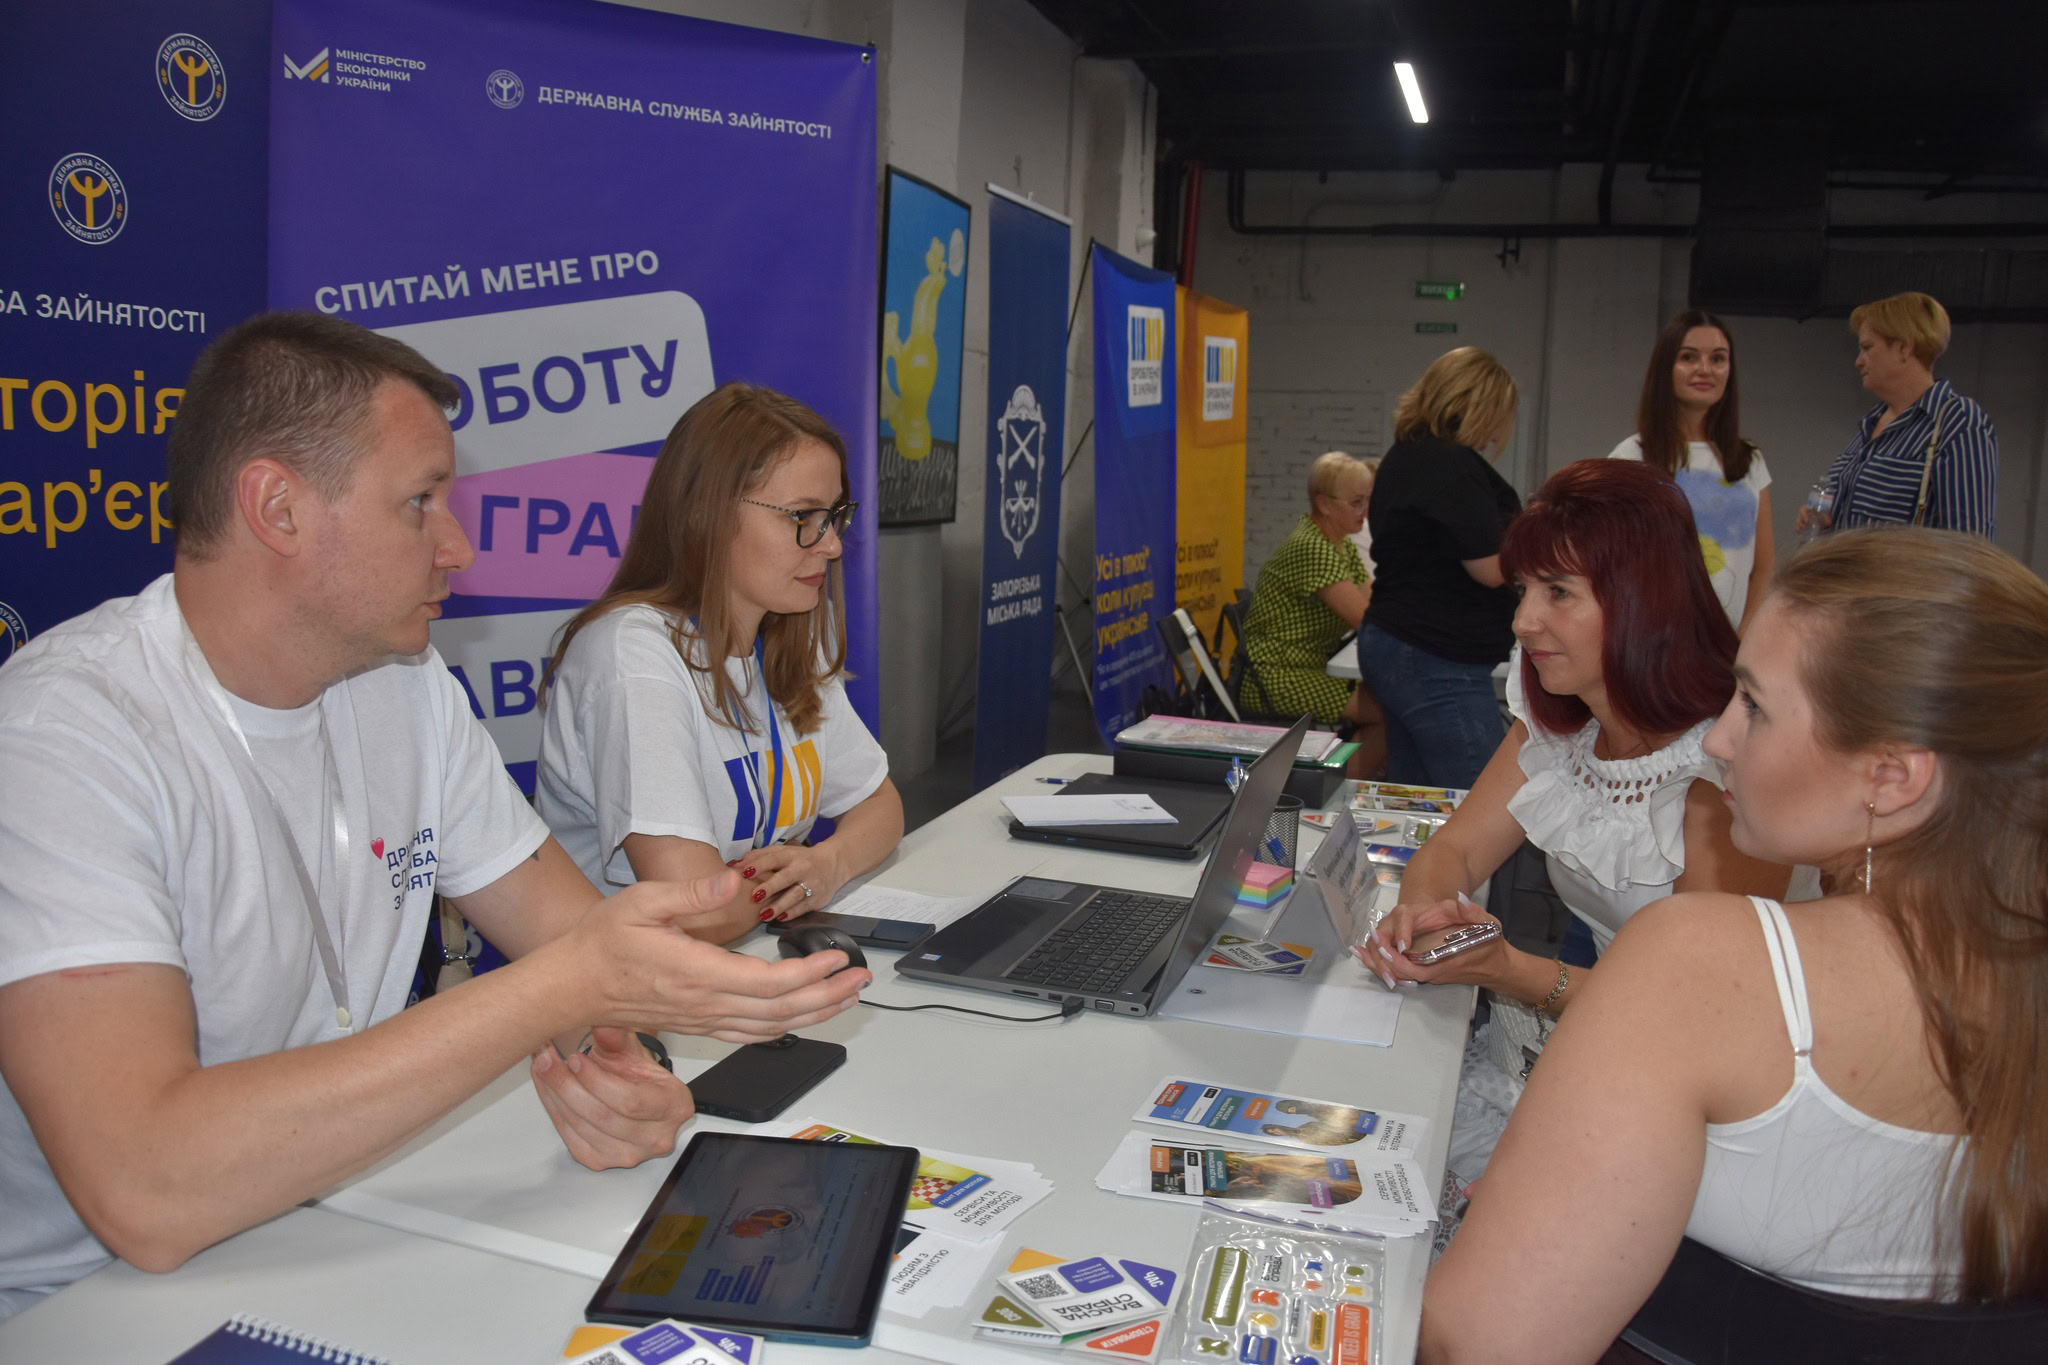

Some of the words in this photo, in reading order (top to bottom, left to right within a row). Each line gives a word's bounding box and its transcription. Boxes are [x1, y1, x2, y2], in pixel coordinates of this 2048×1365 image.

[161, 38, 195, 62] ДЕРЖАВНА
[196, 43, 221, 76] СЛУЖБА
[336, 48, 426, 72] МІНІСТЕРСТВО
[336, 62, 411, 83] ЕКОНОМІКИ
[336, 74, 391, 93] УКРАЇНИ
[170, 95, 214, 117] ЗАЙНЯТОСТІ
[538, 86, 644, 114] ДЕРЖАВНА
[648, 101, 724, 126] СЛУЖБА
[727, 112, 832, 139] ЗАЙНЯТОСТІ
[55, 158, 93, 184] ДЕРЖАВНА
[94, 162, 121, 195] СЛУЖБА
[65, 219, 114, 241] ЗАЙНЯТОСТІ
[314, 264, 470, 314] СПИТАЙ
[480, 258, 582, 294] МЕНЕ
[590, 249, 659, 281] ПРО
[35, 293, 206, 333] ЗАЙНЯТОСТІ
[479, 494, 641, 558] ГРА
[991, 574, 1041, 601] ЗАПОРІЗЬКА
[987, 602, 1021, 626] МІСЬКА
[1022, 596, 1042, 618] РАДА
[1376, 1179, 1390, 1201] СЕРВІСИ
[1385, 1170, 1403, 1204] МОЖЛИВОСТІ
[953, 1196, 985, 1218] СЕРВІСИ
[984, 1189, 998, 1201] ТА
[960, 1190, 1013, 1224] МОЖЛИВОСТІ
[974, 1213, 993, 1227] ДЛЯ
[992, 1195, 1023, 1215] МОЛОДІ
[891, 1259, 922, 1284] ЛЮДЯМ
[921, 1252, 930, 1262] З
[896, 1249, 950, 1295] ІНВАЛІДНІСТЮ
[1144, 1271, 1165, 1288] ЧАС
[1051, 1293, 1134, 1315] СПРАВА
[1060, 1300, 1144, 1322] ВЛАСНА
[1100, 1326, 1155, 1349] СТВОРЮВАТИ
